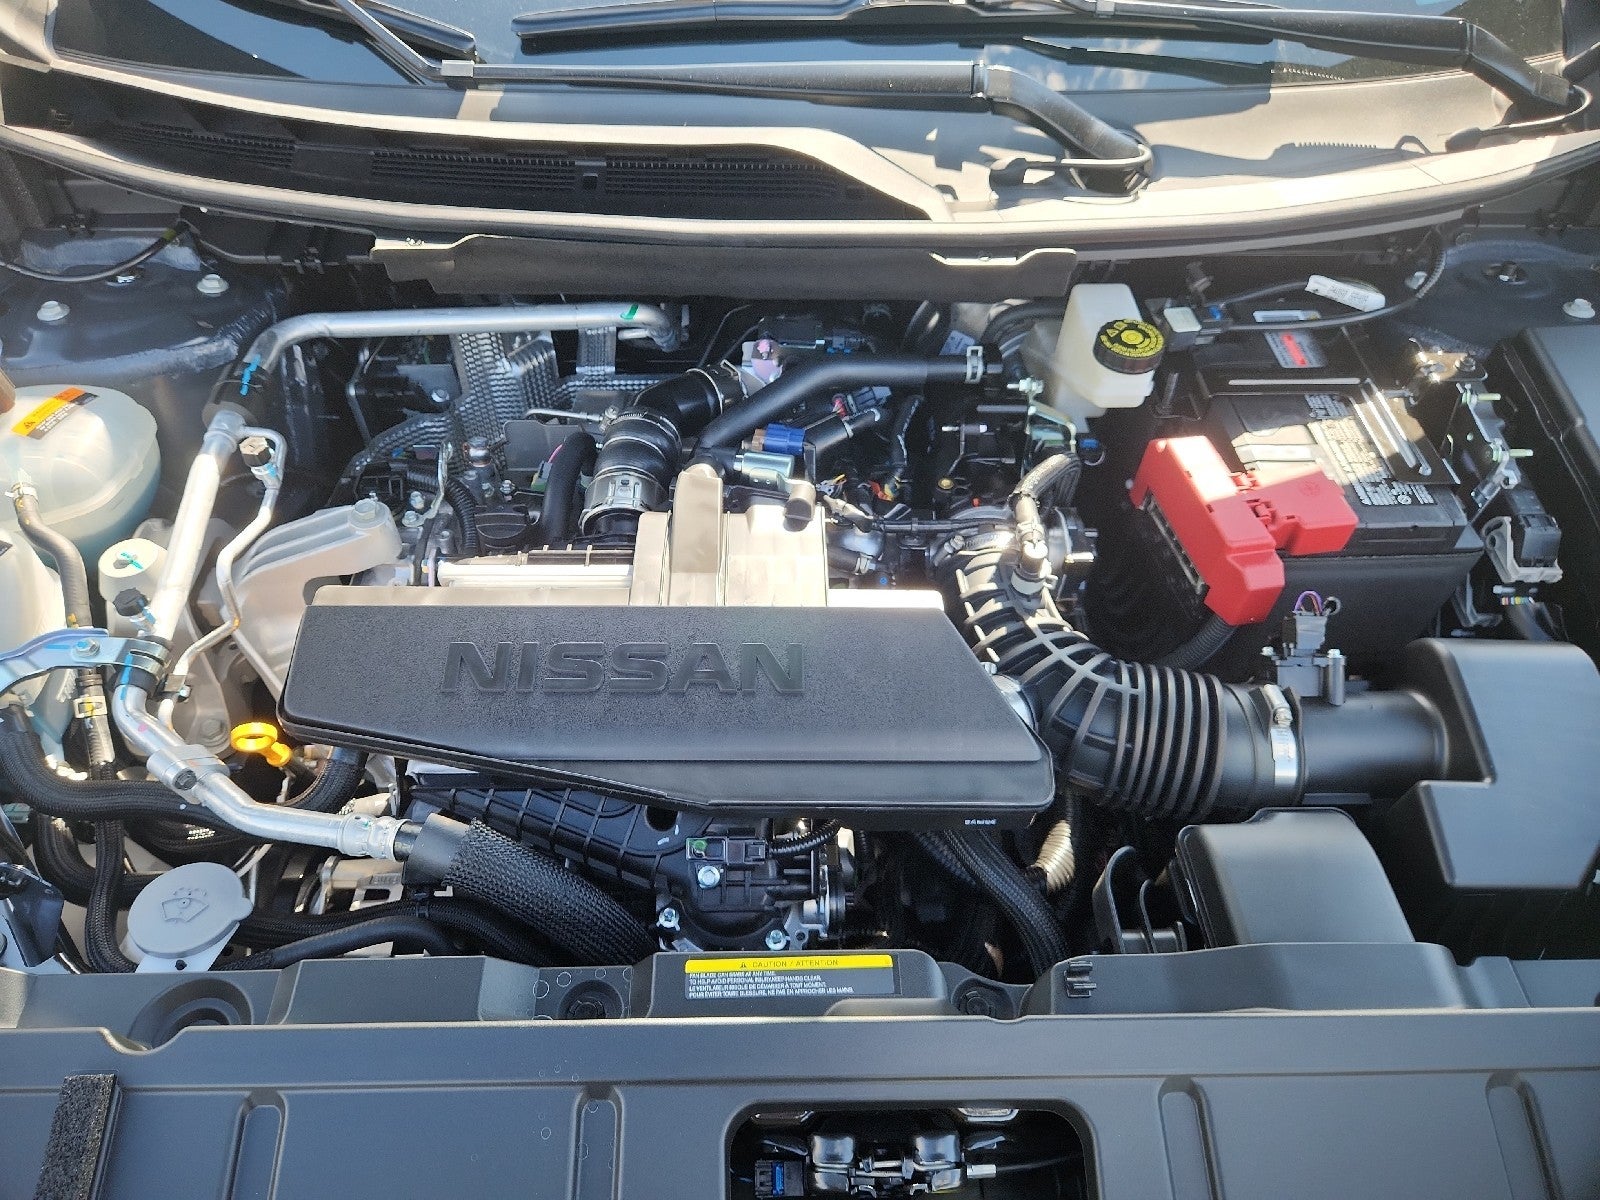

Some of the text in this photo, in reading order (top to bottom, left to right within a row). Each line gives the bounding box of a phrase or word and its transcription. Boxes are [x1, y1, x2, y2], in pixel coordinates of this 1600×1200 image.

[440, 640, 805, 696] NISSAN
[752, 960, 787, 968] CAUTION
[795, 959, 839, 967] ATTENTION
[689, 991, 704, 999] POUR
[794, 987, 826, 995] APPROCHER
